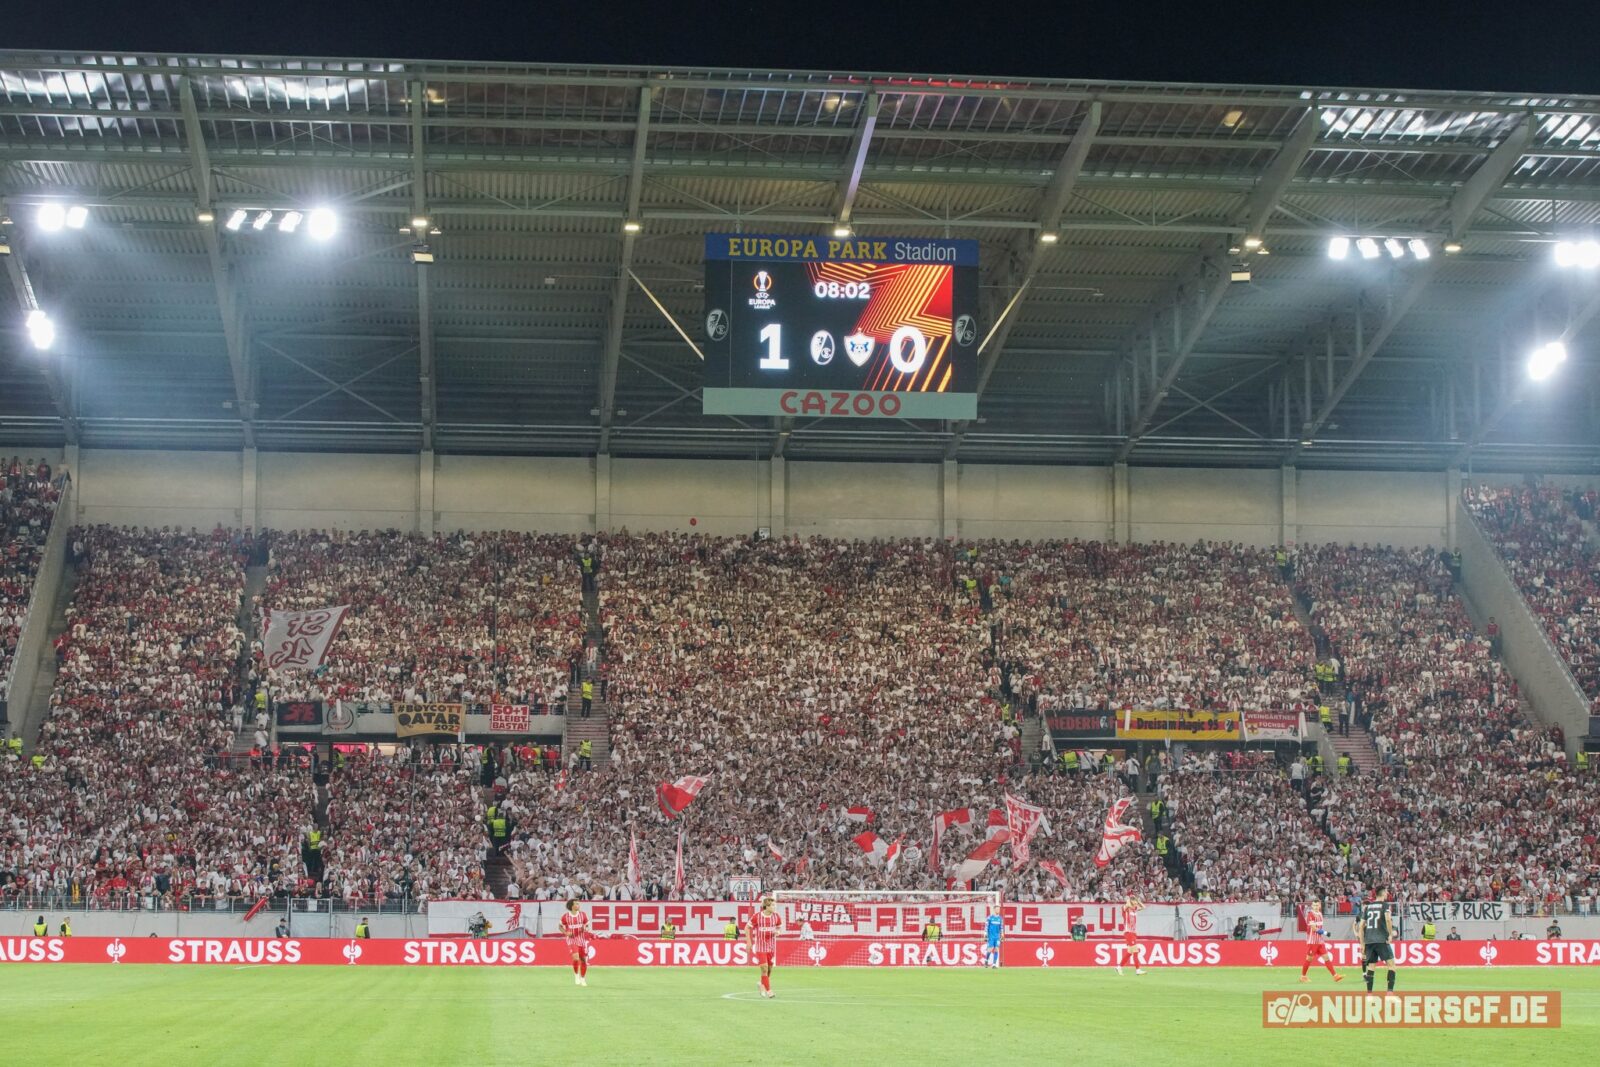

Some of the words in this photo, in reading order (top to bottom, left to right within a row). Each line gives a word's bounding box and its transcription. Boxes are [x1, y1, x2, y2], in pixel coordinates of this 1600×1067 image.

[728, 238, 819, 259] EUROPA
[828, 240, 887, 260] PARK
[894, 242, 957, 261] Stadion
[814, 281, 871, 299] 08:02
[759, 323, 790, 370] 1
[889, 326, 927, 373] 0
[780, 391, 901, 416] CAZOO
[398, 705, 462, 714] #BOYCOTT
[493, 705, 528, 715] 50+1
[398, 713, 461, 726] QATAR
[434, 724, 460, 732] 2022
[492, 722, 527, 730] BASTA!
[795, 911, 852, 922] MAFIA
[801, 903, 847, 913] UEFA
[1367, 910, 1380, 929] 27
[168, 940, 301, 963] STRAUSS
[403, 941, 536, 964] STRAUSS
